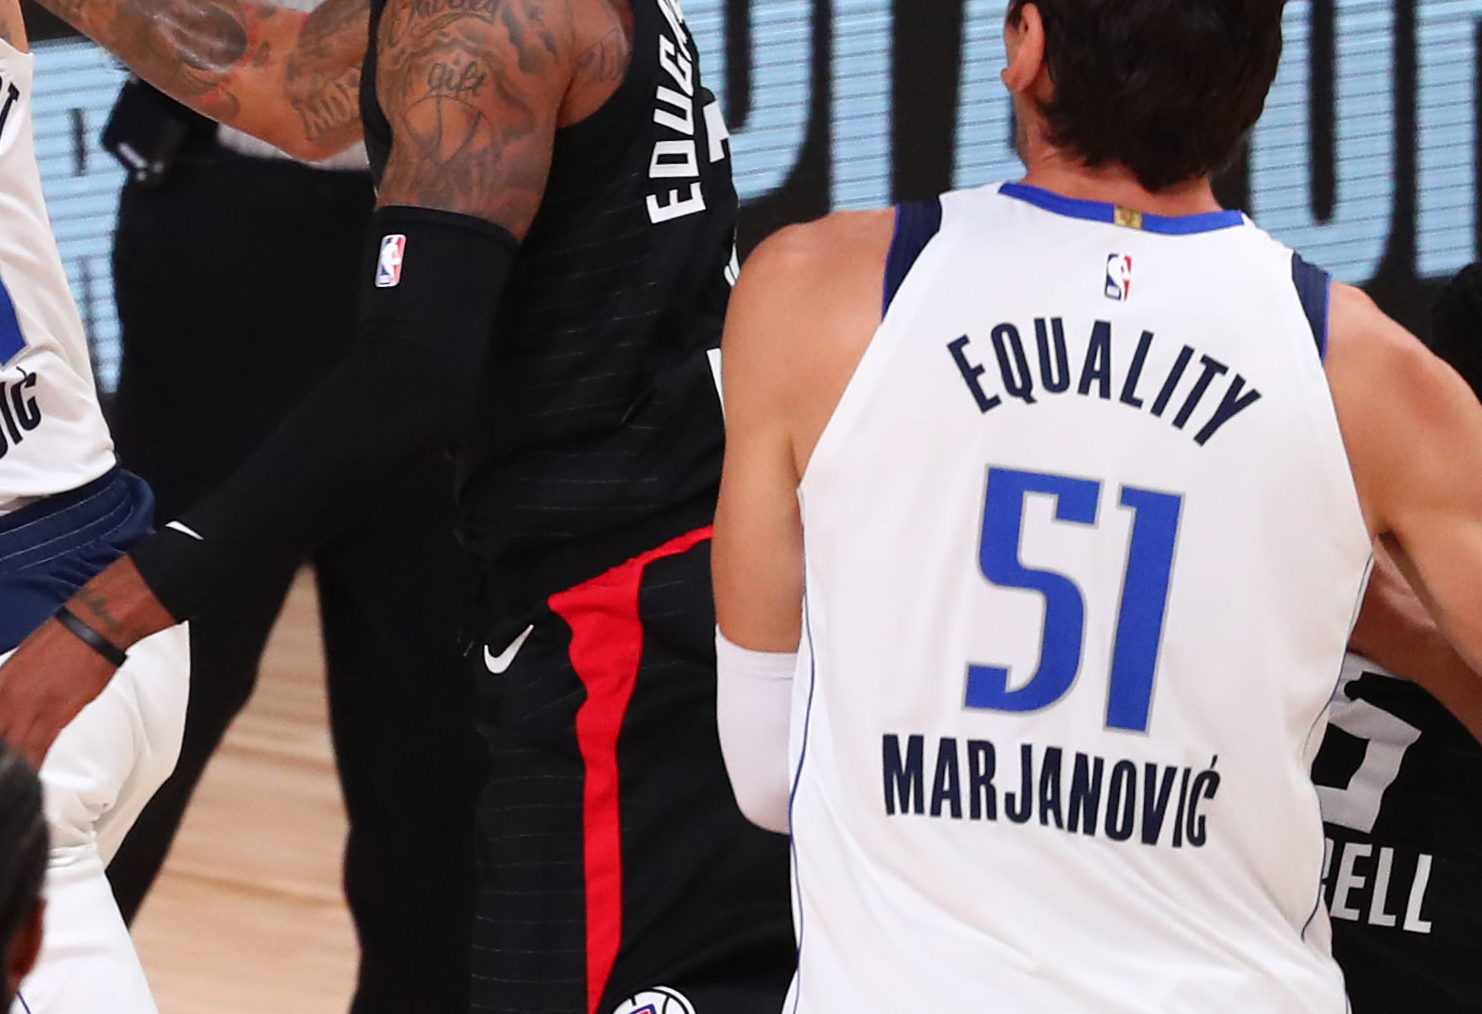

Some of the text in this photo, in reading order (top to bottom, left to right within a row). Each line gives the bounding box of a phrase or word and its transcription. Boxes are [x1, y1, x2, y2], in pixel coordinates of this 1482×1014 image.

[947, 317, 1262, 446] EQUALITY
[962, 463, 1186, 737] 51
[882, 733, 1221, 849] MARJANOVIĆ
[1320, 836, 1433, 934] ELL
